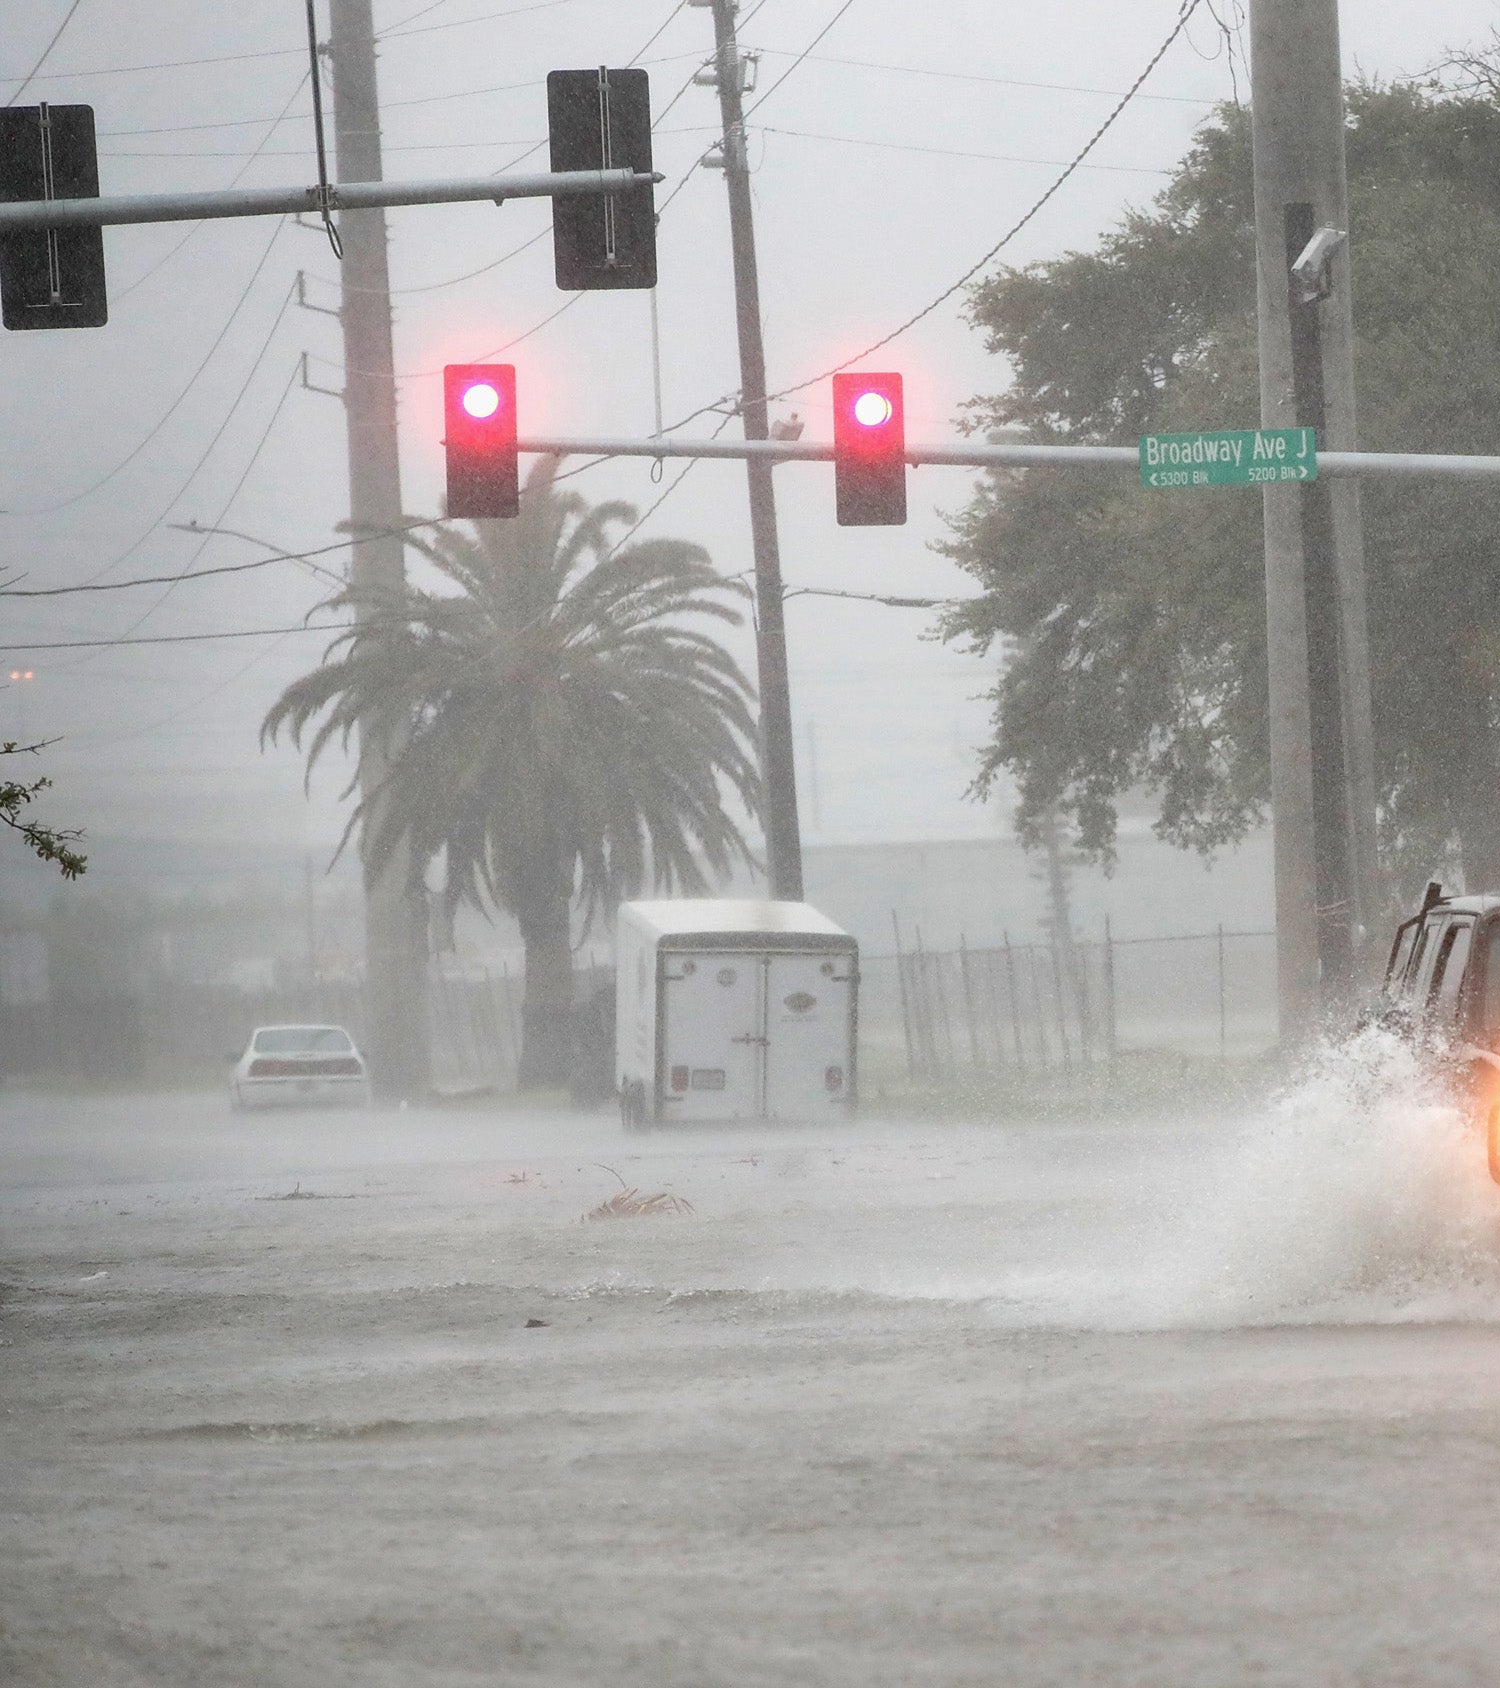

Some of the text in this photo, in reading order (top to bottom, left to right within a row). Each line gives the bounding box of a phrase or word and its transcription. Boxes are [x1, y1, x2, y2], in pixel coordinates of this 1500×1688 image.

[1147, 430, 1307, 466] Broadway Ave J
[1160, 472, 1188, 487] 5300
[1248, 466, 1297, 482] 5200 Blk
